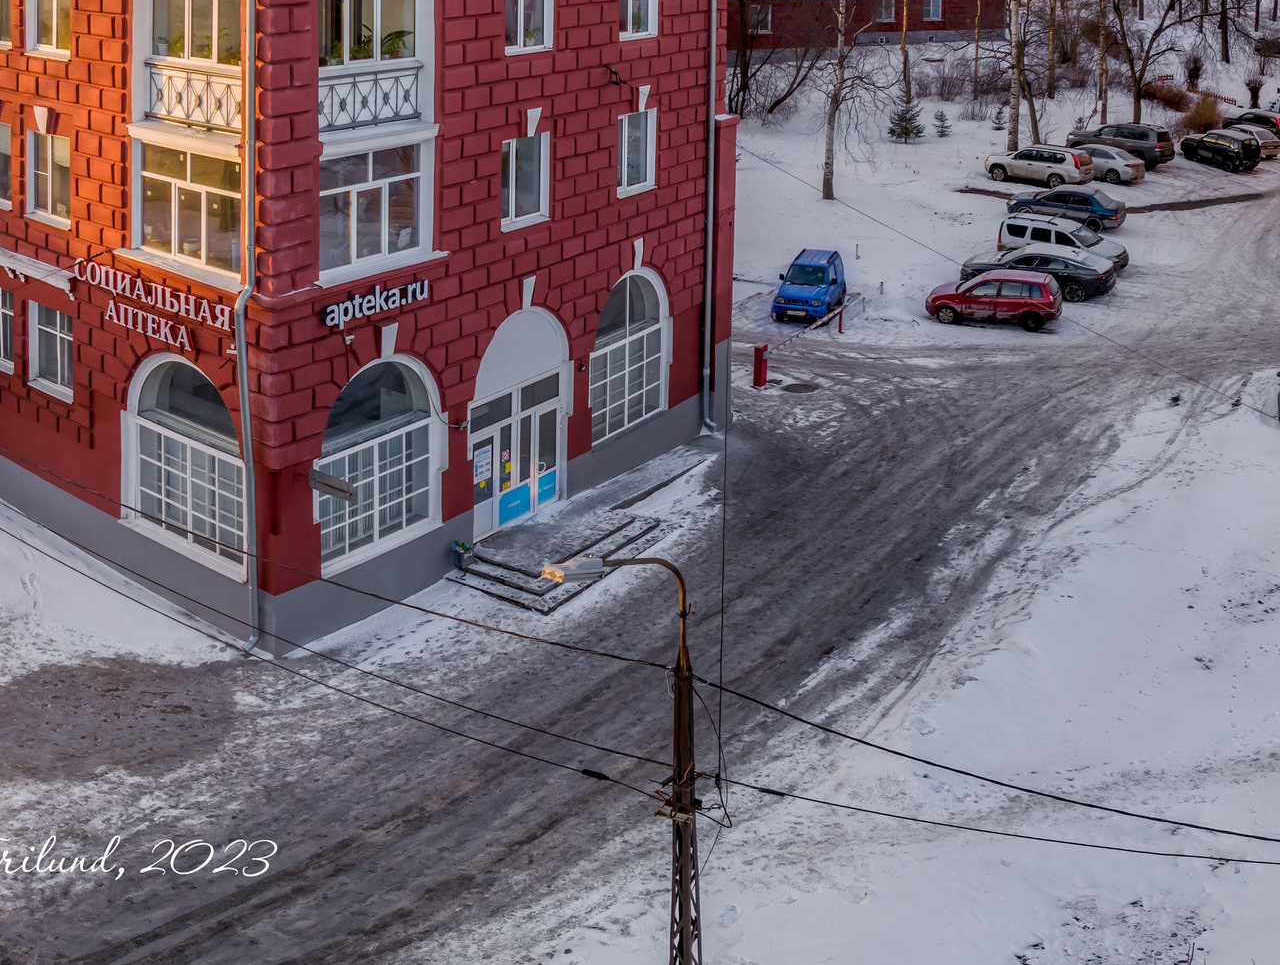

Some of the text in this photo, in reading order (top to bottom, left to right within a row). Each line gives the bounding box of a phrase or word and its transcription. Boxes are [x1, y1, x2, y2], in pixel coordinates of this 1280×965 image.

[74, 257, 233, 332] СОЦИАЛЬНАЯ
[325, 279, 429, 330] apteka.ru
[104, 299, 194, 352] АПТЕКА
